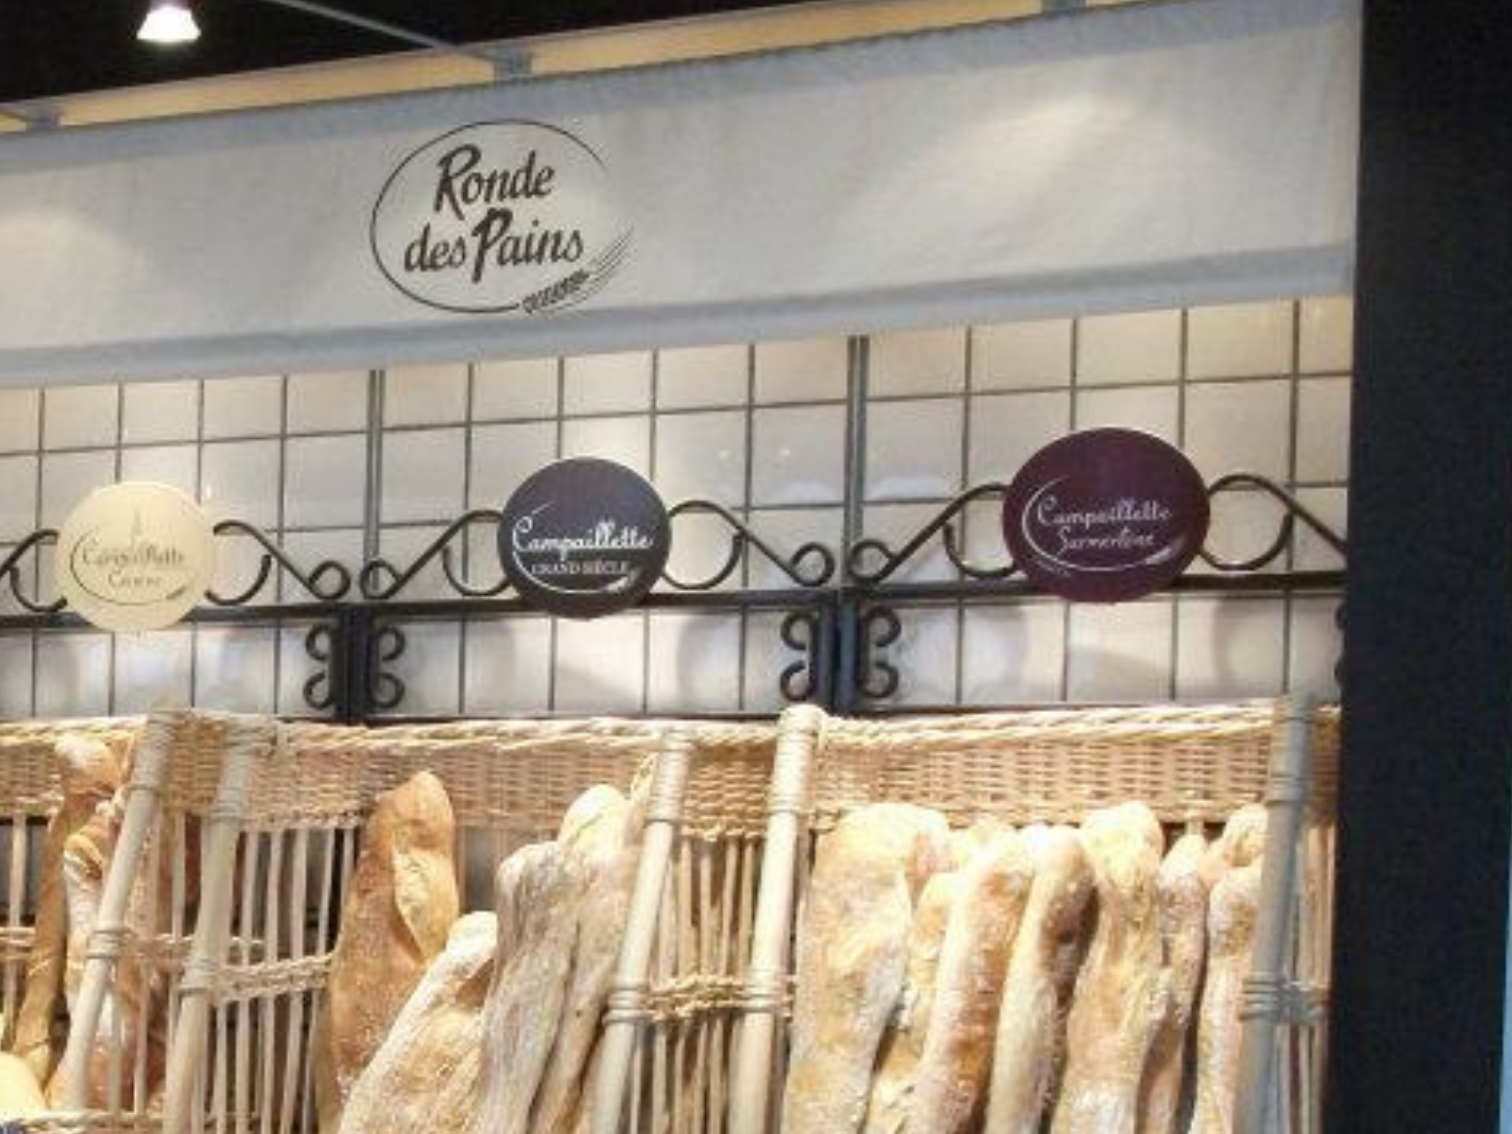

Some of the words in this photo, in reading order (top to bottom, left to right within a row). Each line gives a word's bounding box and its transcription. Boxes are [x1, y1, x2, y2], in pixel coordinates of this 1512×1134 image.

[434, 144, 555, 221] Ronde
[404, 223, 467, 273] des
[471, 207, 584, 284] Pains
[512, 516, 654, 562] Campaillette
[1038, 496, 1172, 530] Campaillette
